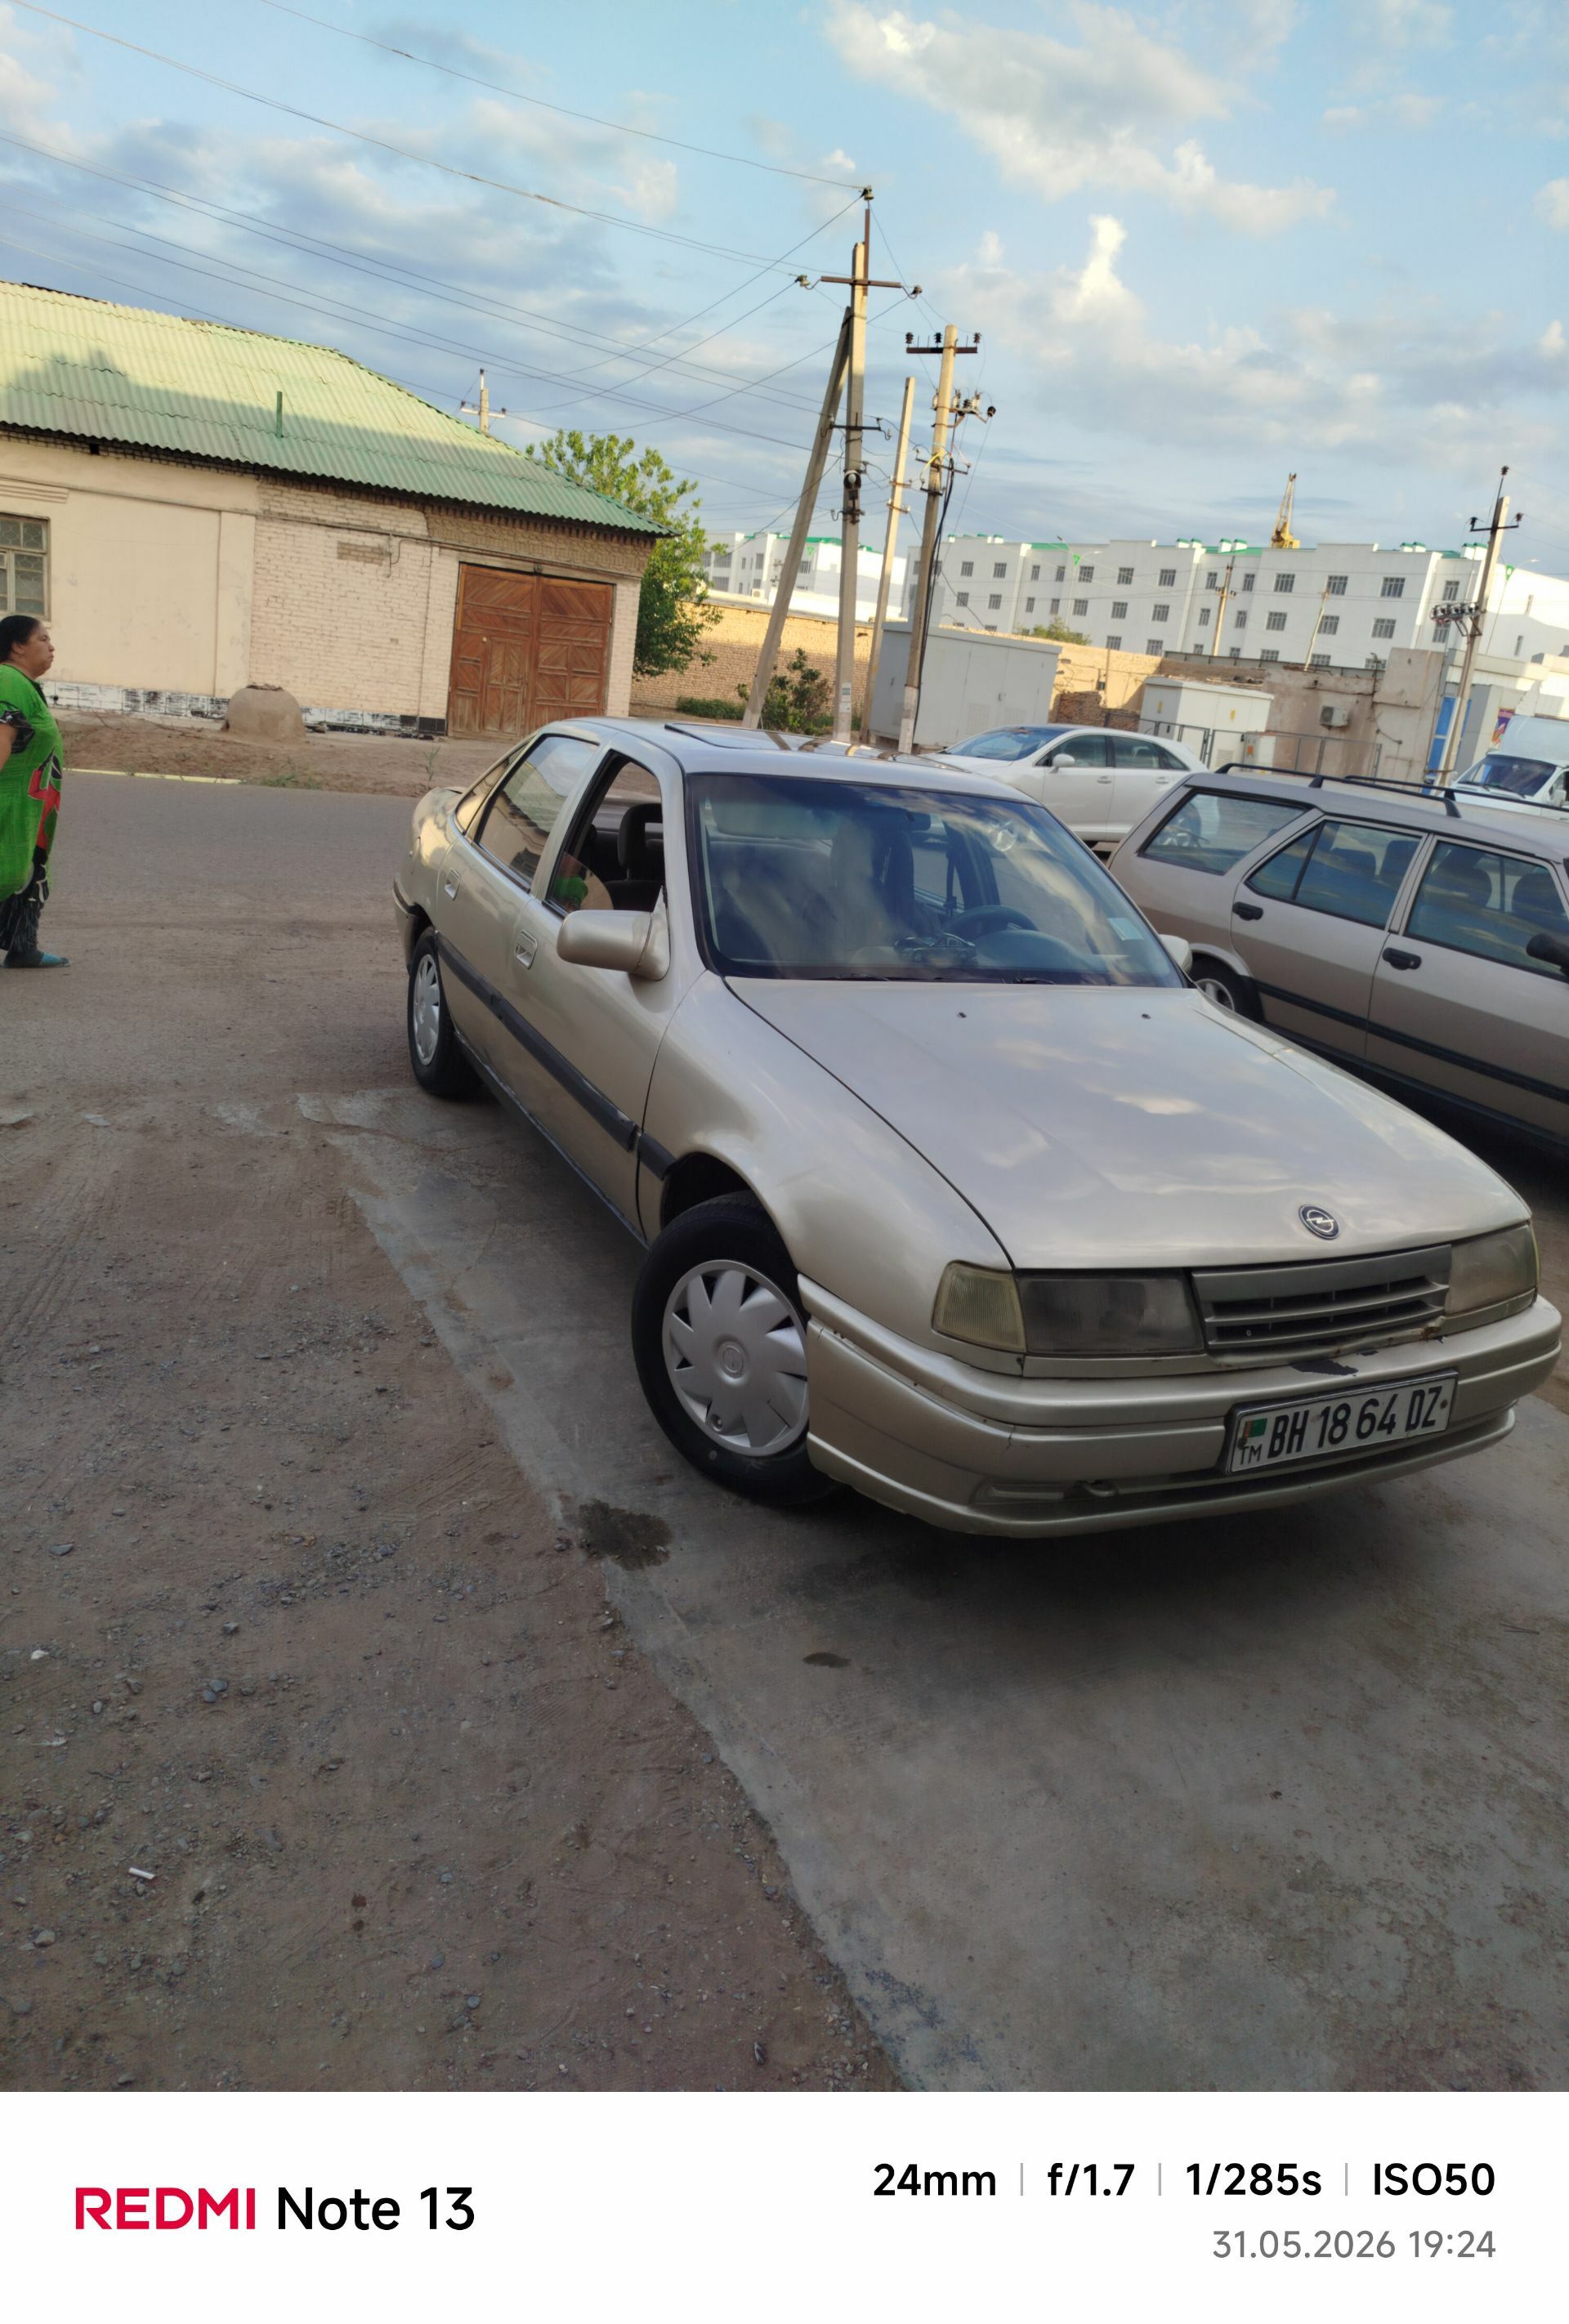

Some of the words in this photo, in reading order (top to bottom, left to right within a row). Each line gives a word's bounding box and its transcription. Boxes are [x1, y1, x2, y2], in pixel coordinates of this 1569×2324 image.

[1267, 1410, 1309, 1459] BH
[1317, 1402, 1351, 1448] 18
[1356, 1393, 1398, 1440] 64
[1405, 1386, 1442, 1432] DZ
[1240, 1443, 1263, 1465] TM
